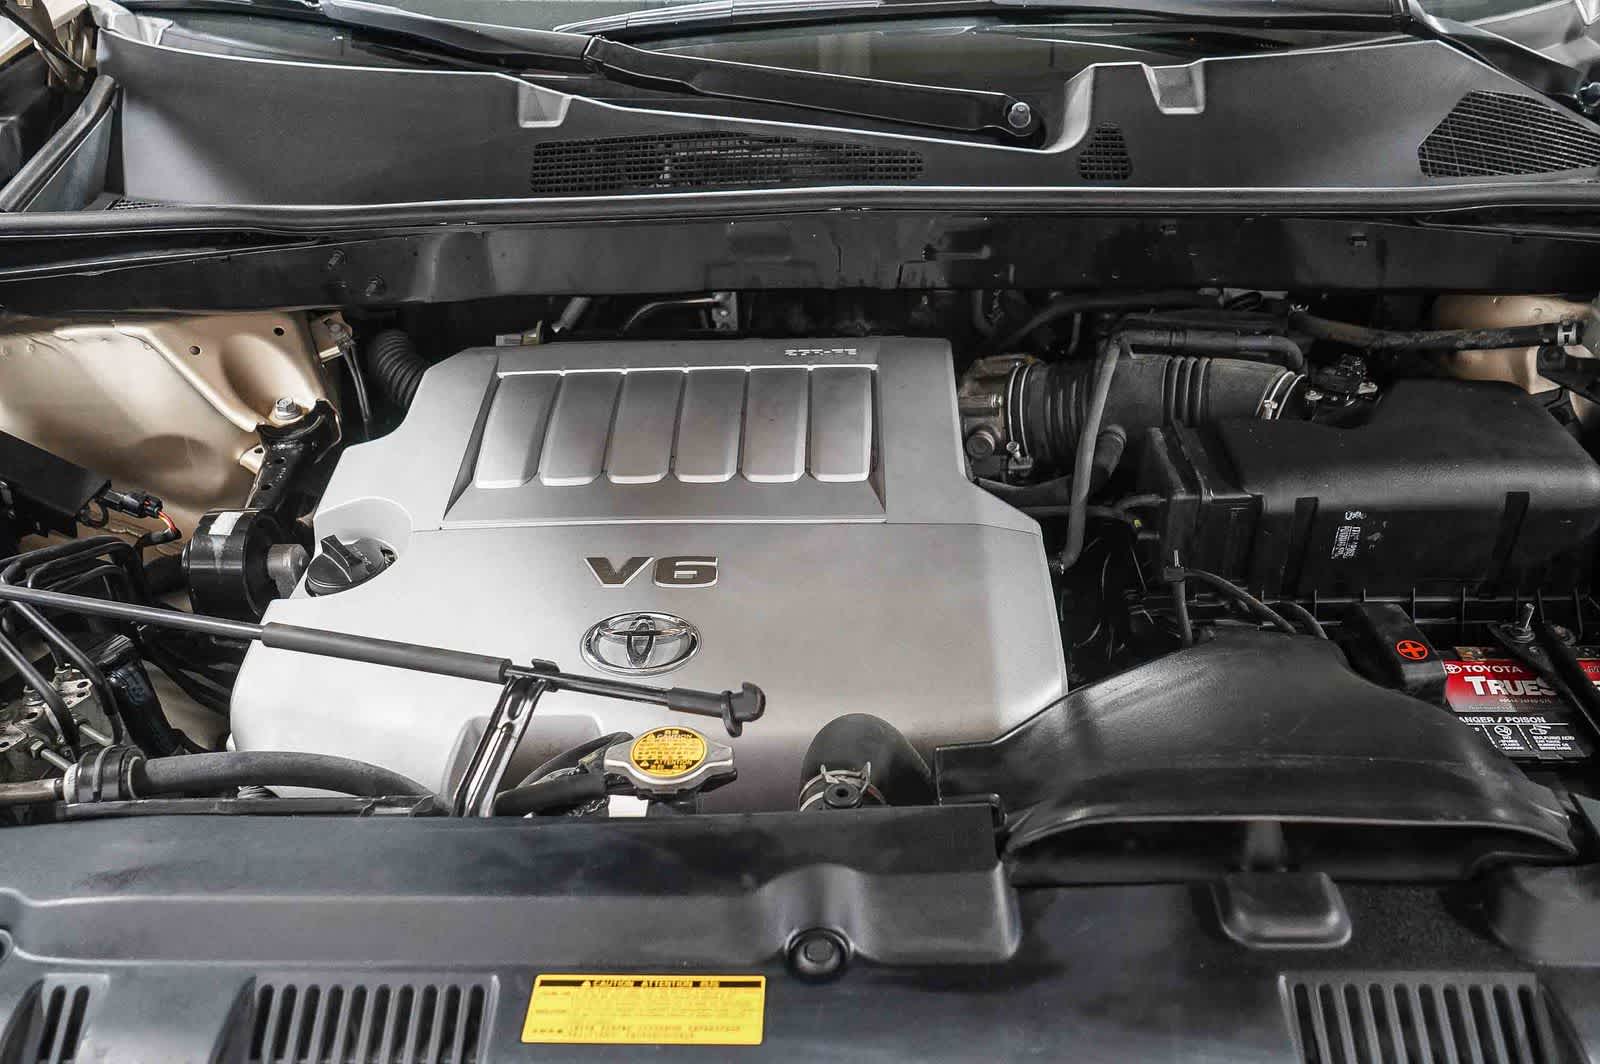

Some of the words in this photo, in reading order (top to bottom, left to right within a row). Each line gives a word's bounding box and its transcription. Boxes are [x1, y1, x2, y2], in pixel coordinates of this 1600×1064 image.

[584, 556, 718, 589] V6
[1462, 664, 1523, 673] TOYOTA
[1463, 676, 1557, 696] TRUES
